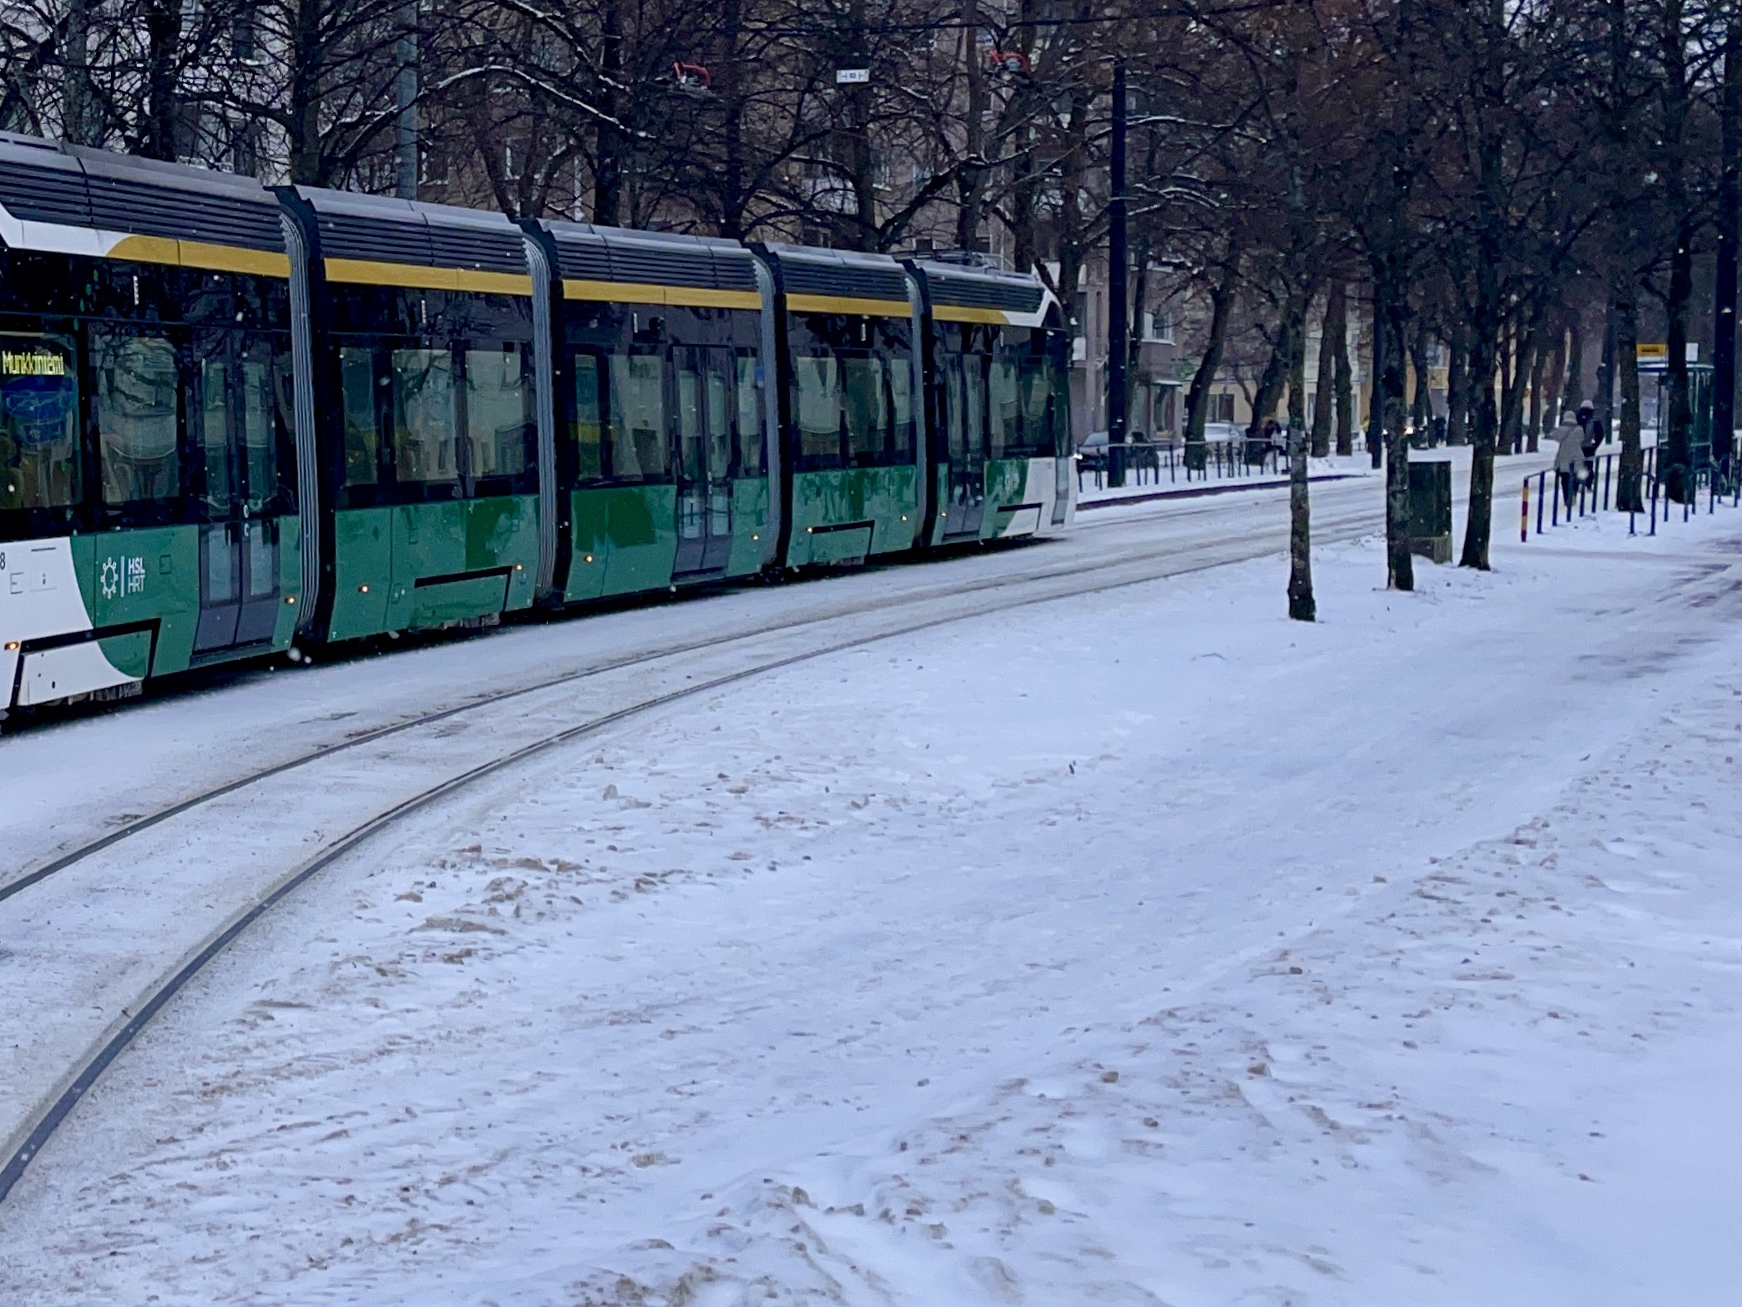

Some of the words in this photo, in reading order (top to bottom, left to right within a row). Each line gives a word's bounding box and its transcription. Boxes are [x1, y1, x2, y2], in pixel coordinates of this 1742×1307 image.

[1, 349, 65, 375] Munkkiniemi
[128, 557, 146, 574] HSL
[127, 575, 146, 593] HRT
